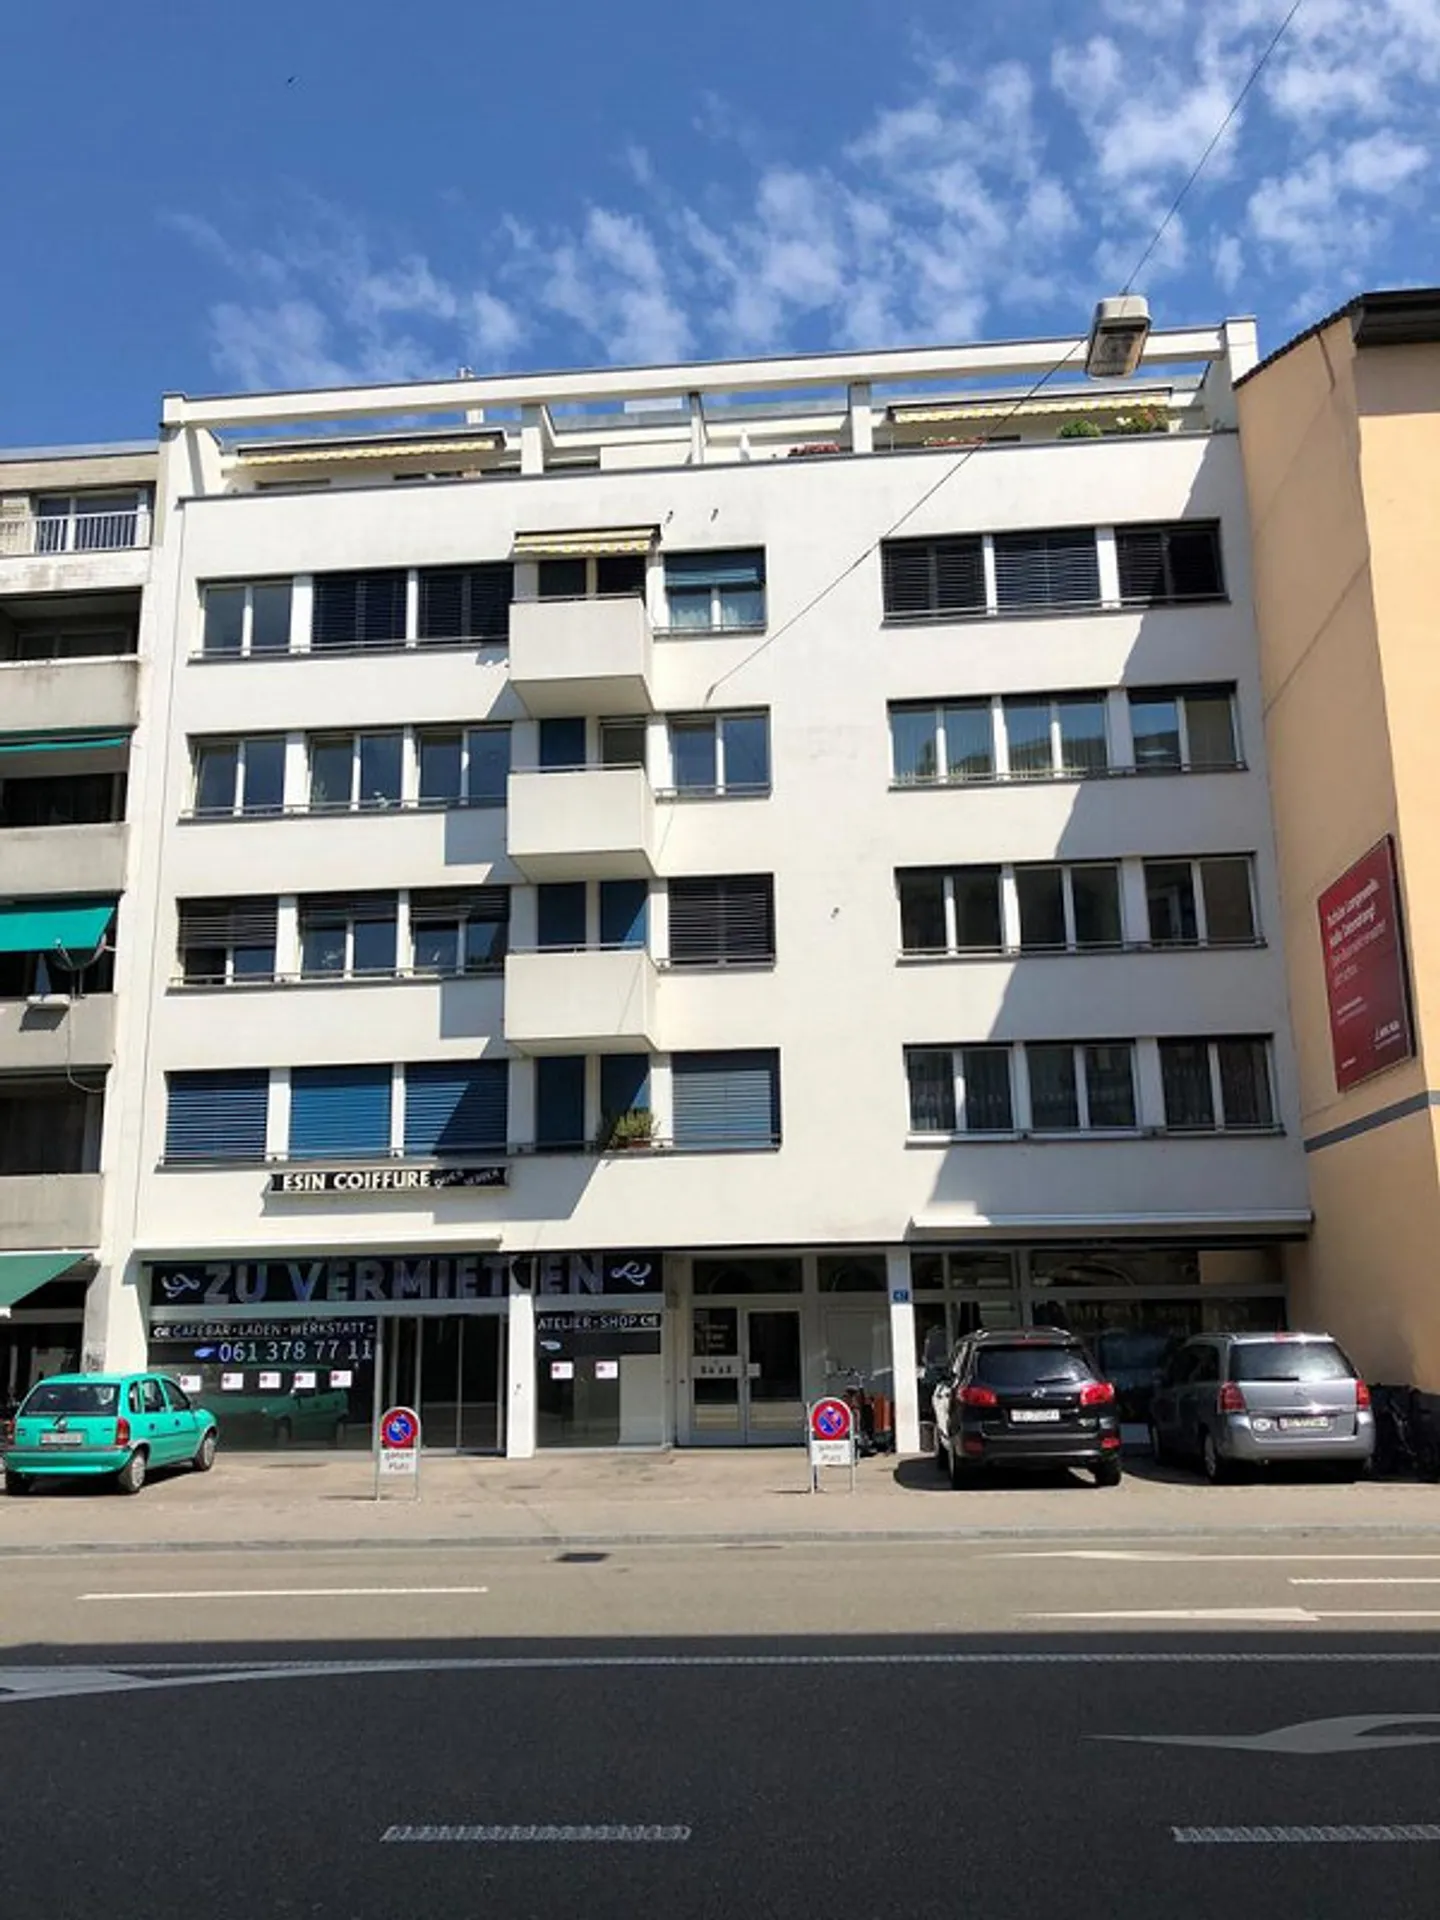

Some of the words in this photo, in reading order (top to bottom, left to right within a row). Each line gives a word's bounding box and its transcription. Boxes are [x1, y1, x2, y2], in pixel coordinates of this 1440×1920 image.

[283, 1172, 326, 1191] ESIN
[333, 1170, 431, 1190] COIFFURE
[203, 1262, 269, 1305] ZU
[286, 1253, 604, 1304] VERMIETEN
[217, 1341, 258, 1362] 061
[266, 1341, 307, 1361] 378
[314, 1340, 341, 1360] 77
[347, 1340, 373, 1360] 11
